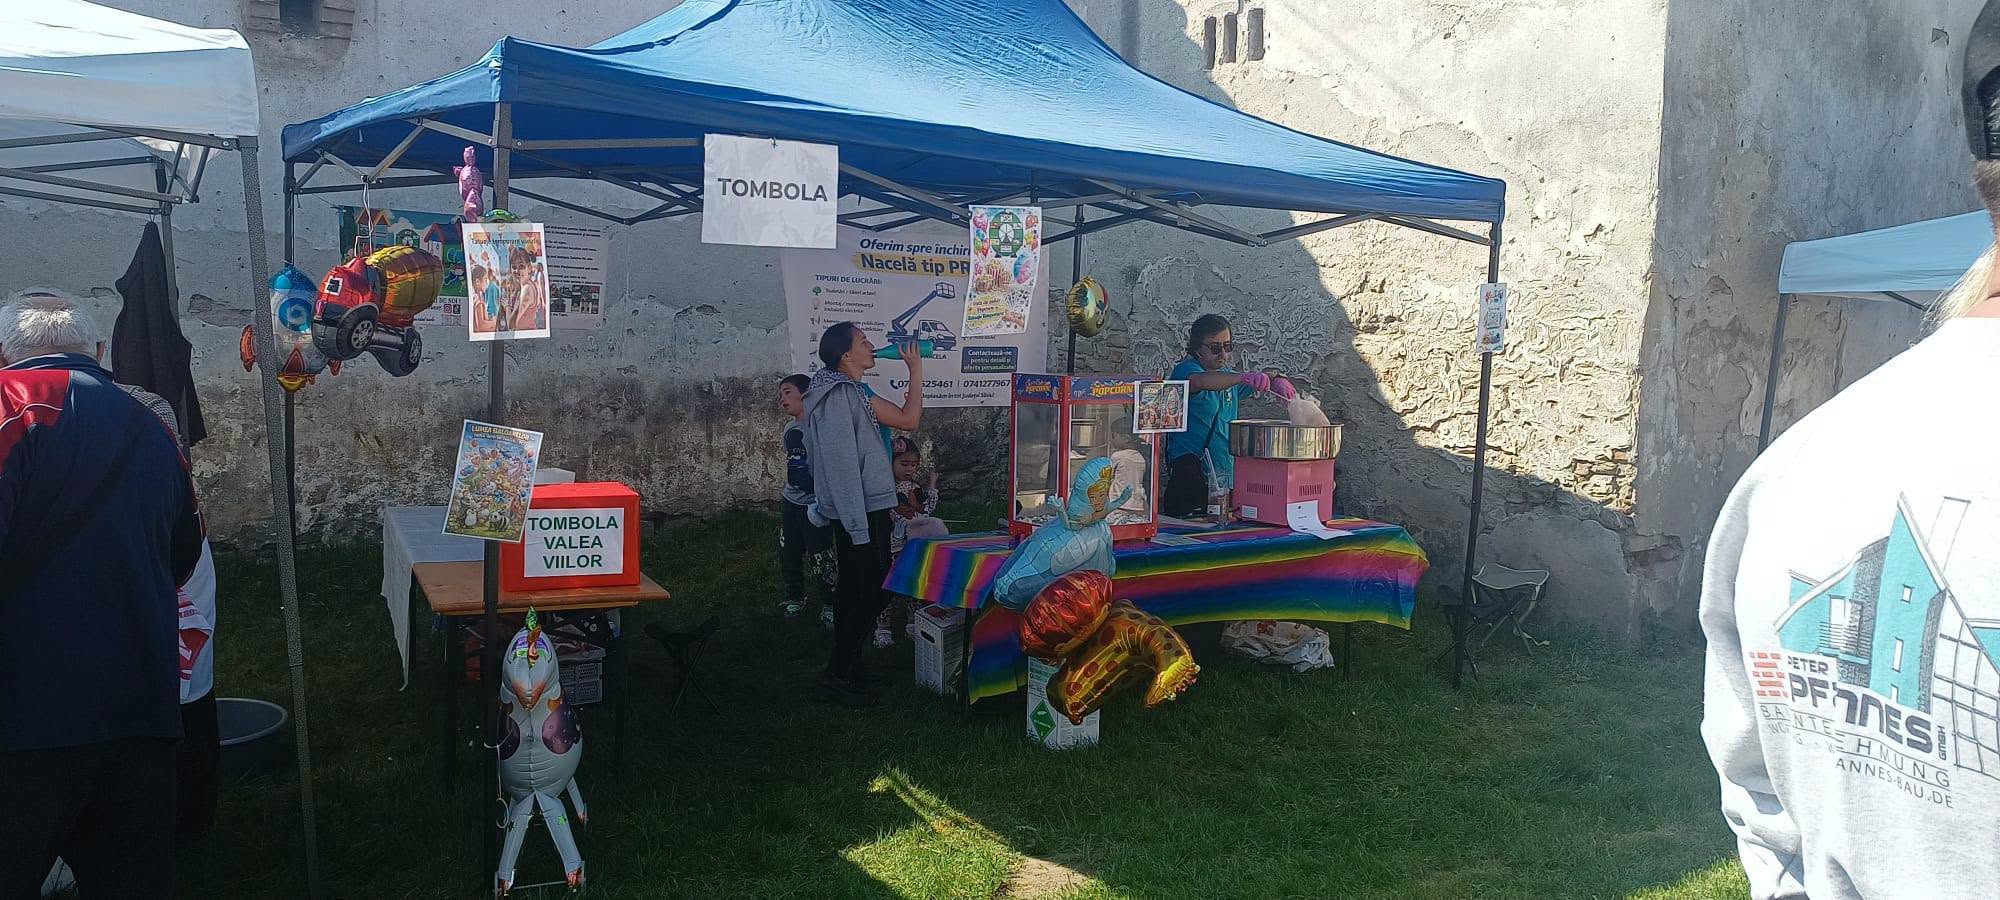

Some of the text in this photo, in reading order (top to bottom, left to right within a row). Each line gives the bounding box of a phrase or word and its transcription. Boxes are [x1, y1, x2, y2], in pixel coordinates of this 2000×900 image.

[717, 177, 828, 202] TOMBOLA
[860, 238, 971, 256] Oferim spre închiri
[861, 253, 971, 276] Nacelă tip PR
[963, 379, 1010, 388] 0741277967
[1092, 384, 1134, 397] POPCORN
[528, 515, 619, 531] TOMBOLA
[543, 535, 604, 550] VALEA
[542, 554, 603, 570] VIILOR
